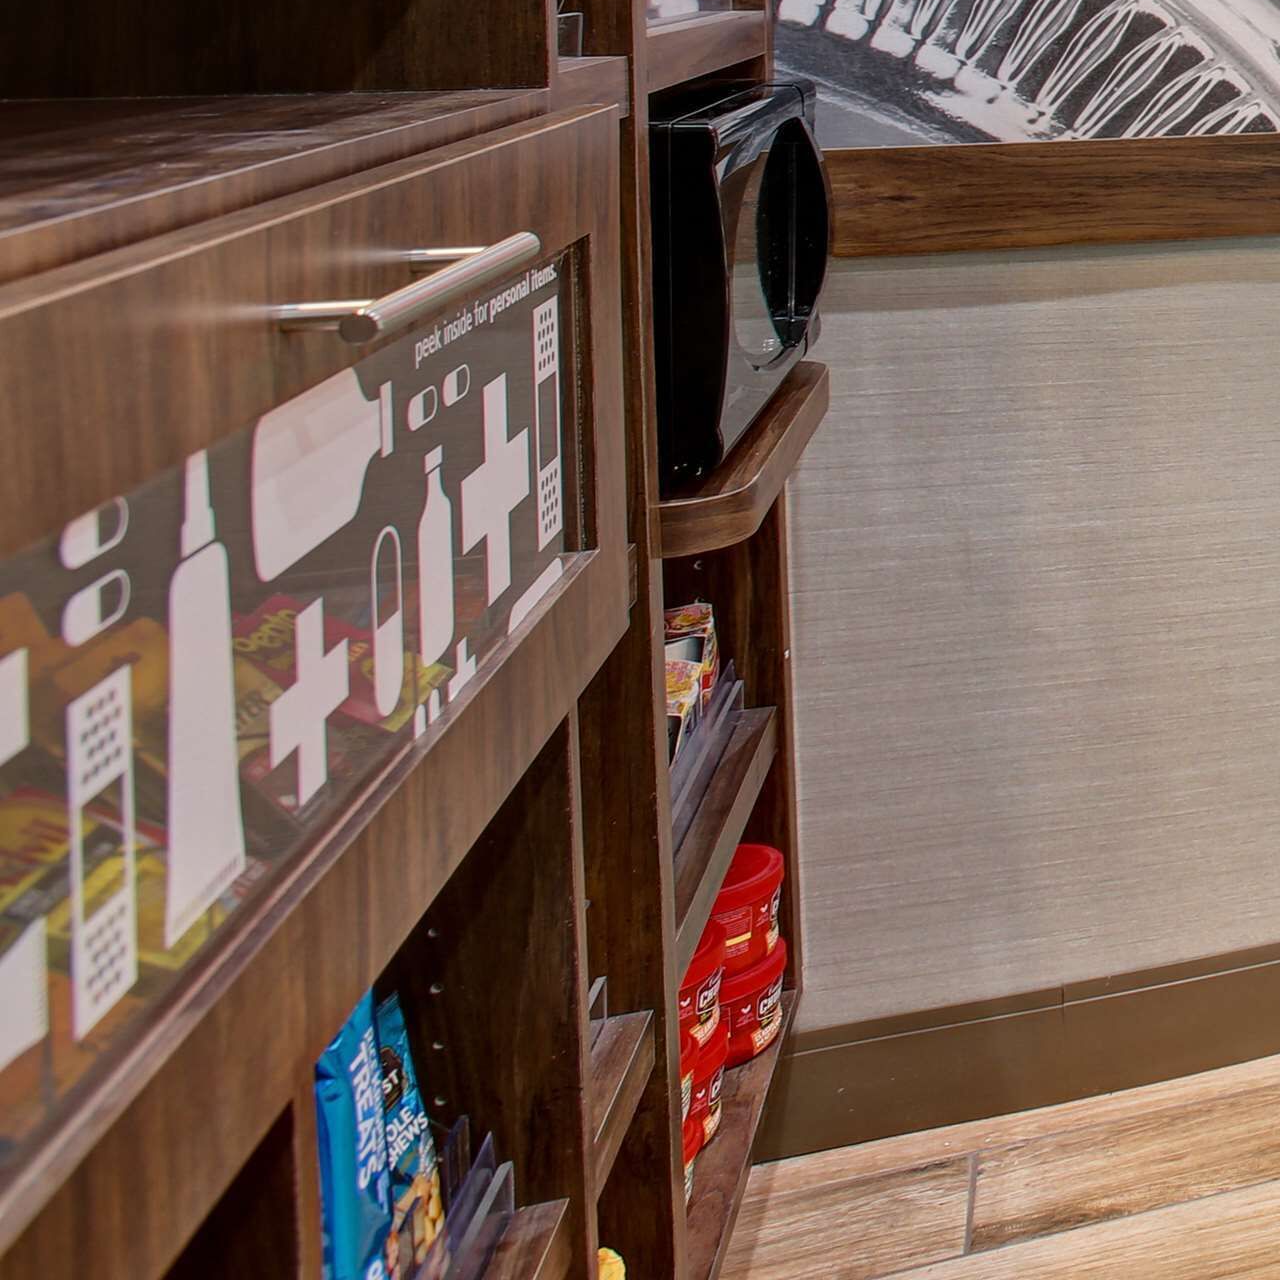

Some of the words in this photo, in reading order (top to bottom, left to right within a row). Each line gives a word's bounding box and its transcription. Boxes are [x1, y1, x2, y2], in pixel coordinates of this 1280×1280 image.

[415, 328, 443, 369] peek
[443, 312, 474, 345] inside
[474, 300, 489, 326] for
[489, 272, 530, 322] personal
[530, 262, 559, 292] items.
[350, 1040, 378, 1190] TREATS
